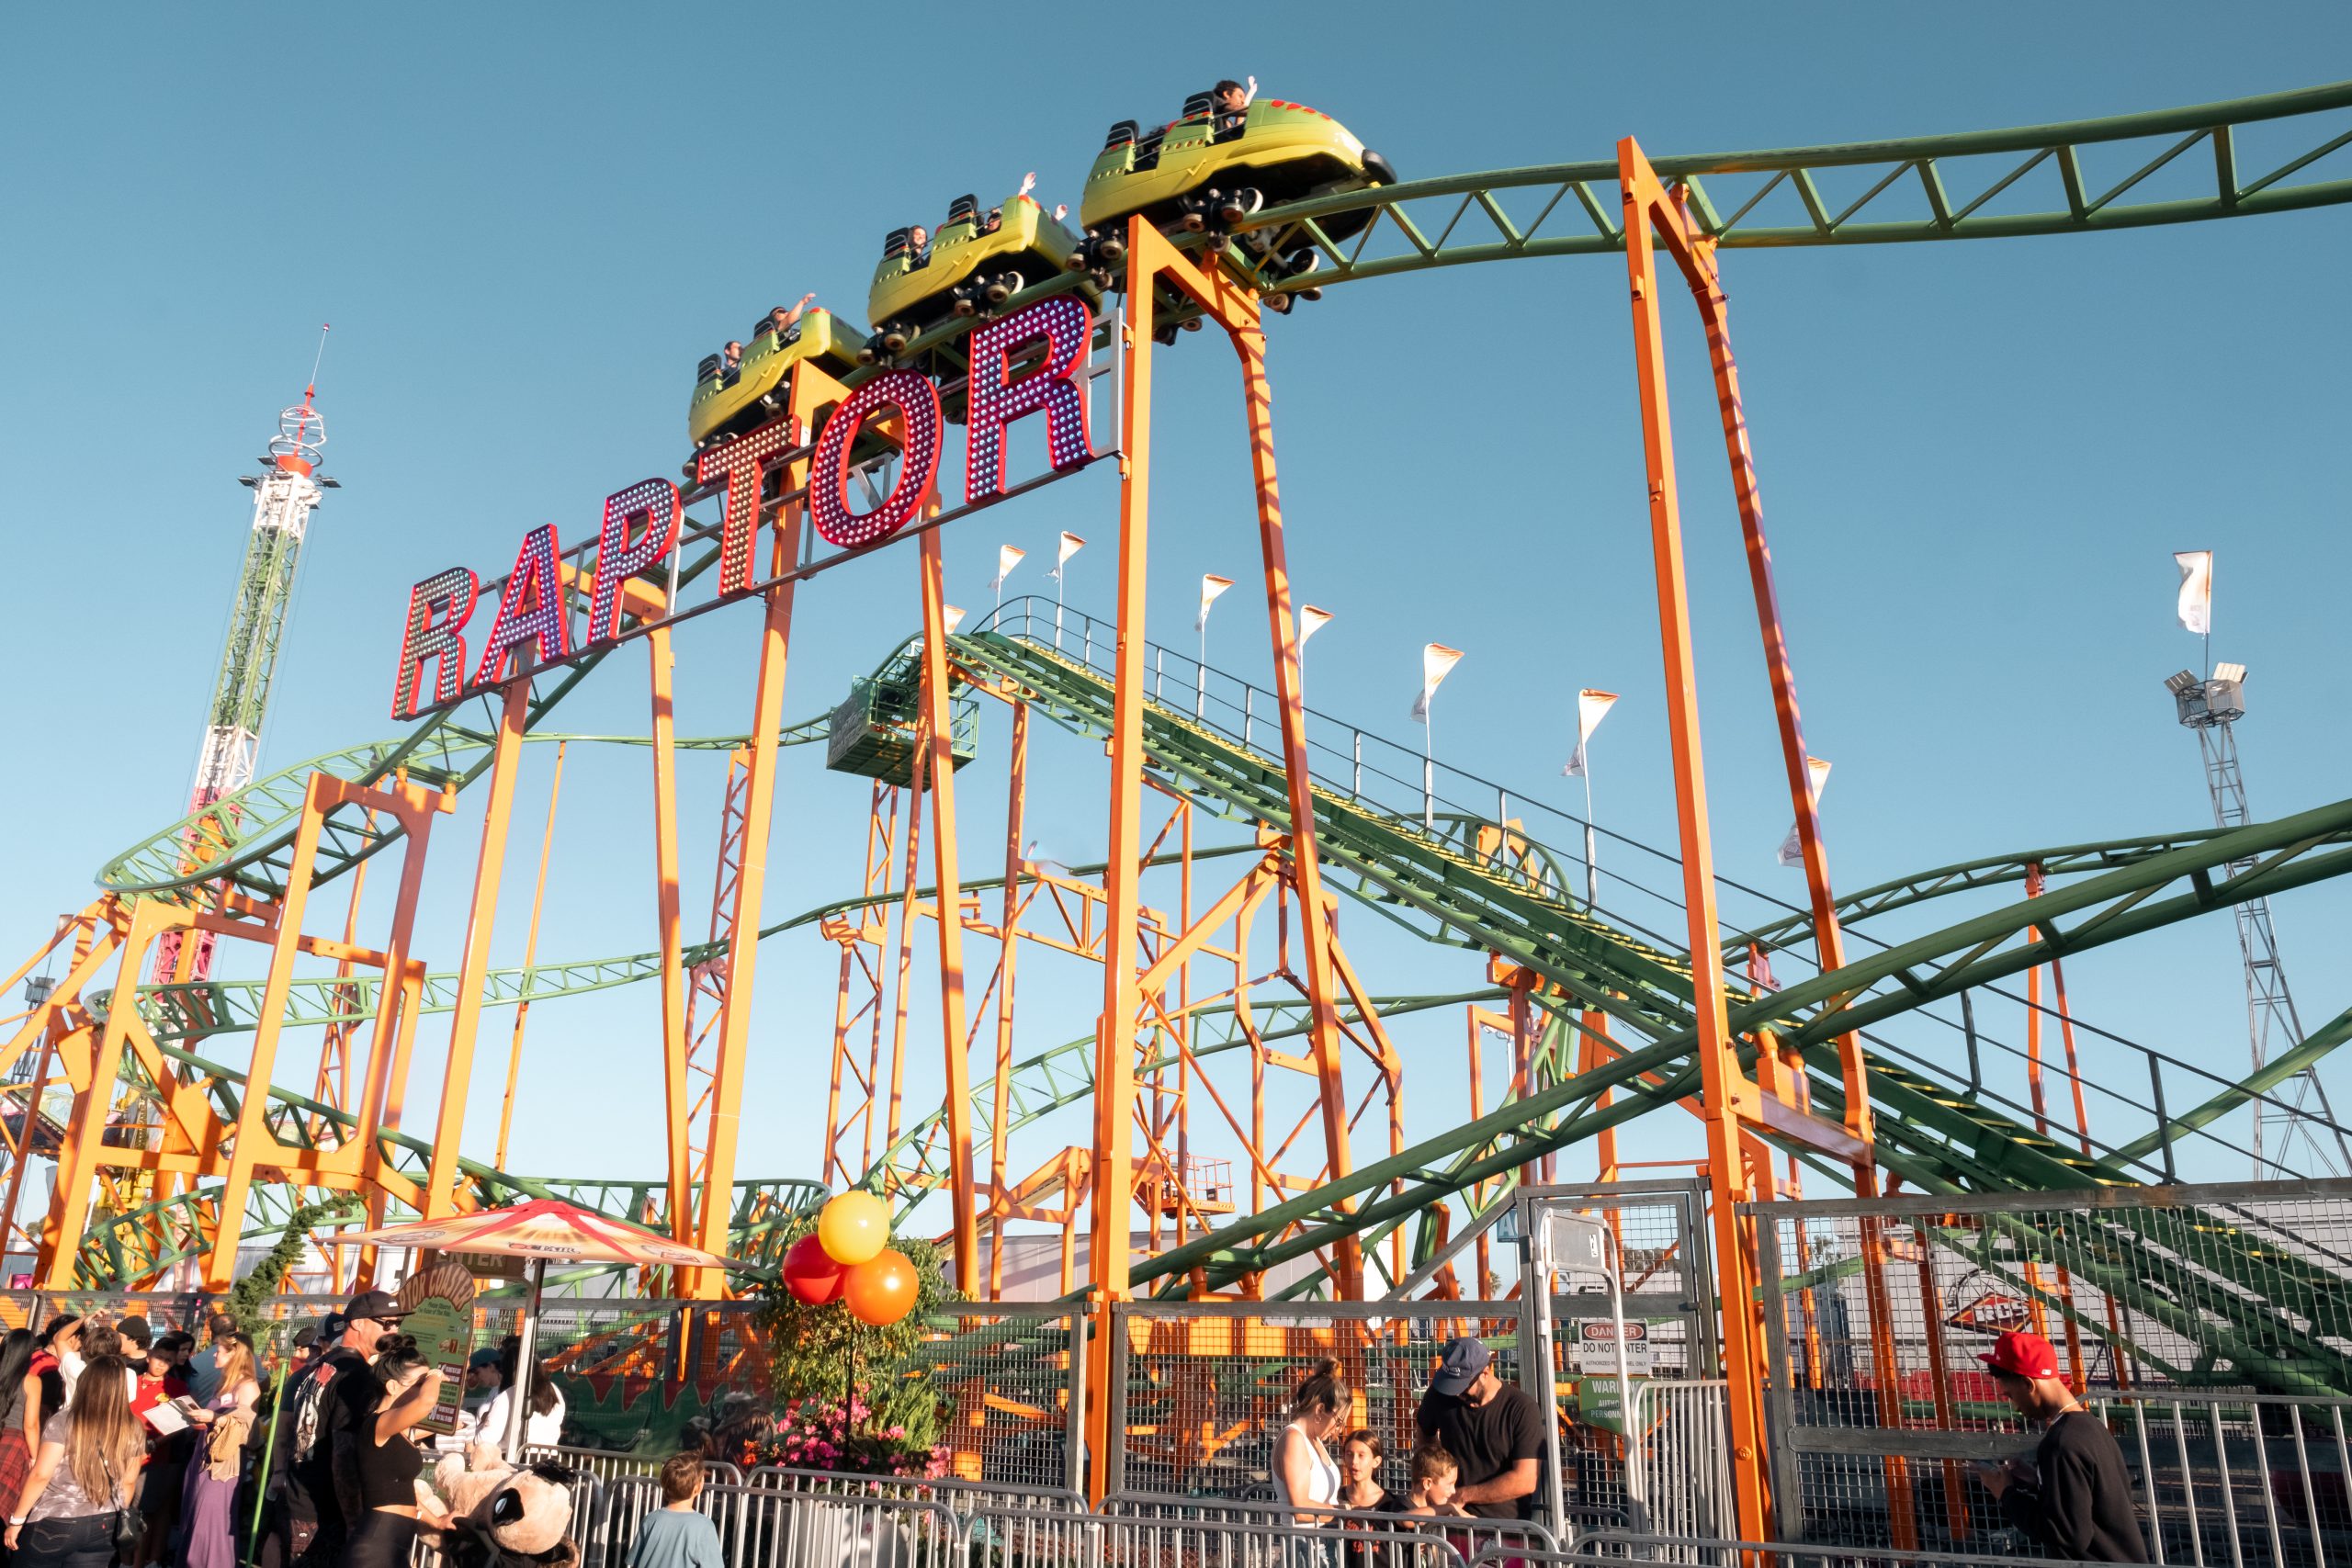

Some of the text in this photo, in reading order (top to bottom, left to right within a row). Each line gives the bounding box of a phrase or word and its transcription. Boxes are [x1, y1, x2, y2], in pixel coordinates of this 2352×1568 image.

[390, 293, 1095, 721] RAPTOR
[399, 1264, 475, 1312] PTOR COASTER
[1591, 1326, 1636, 1337] DANER
[1583, 1342, 1647, 1353] DO NOT NTER
